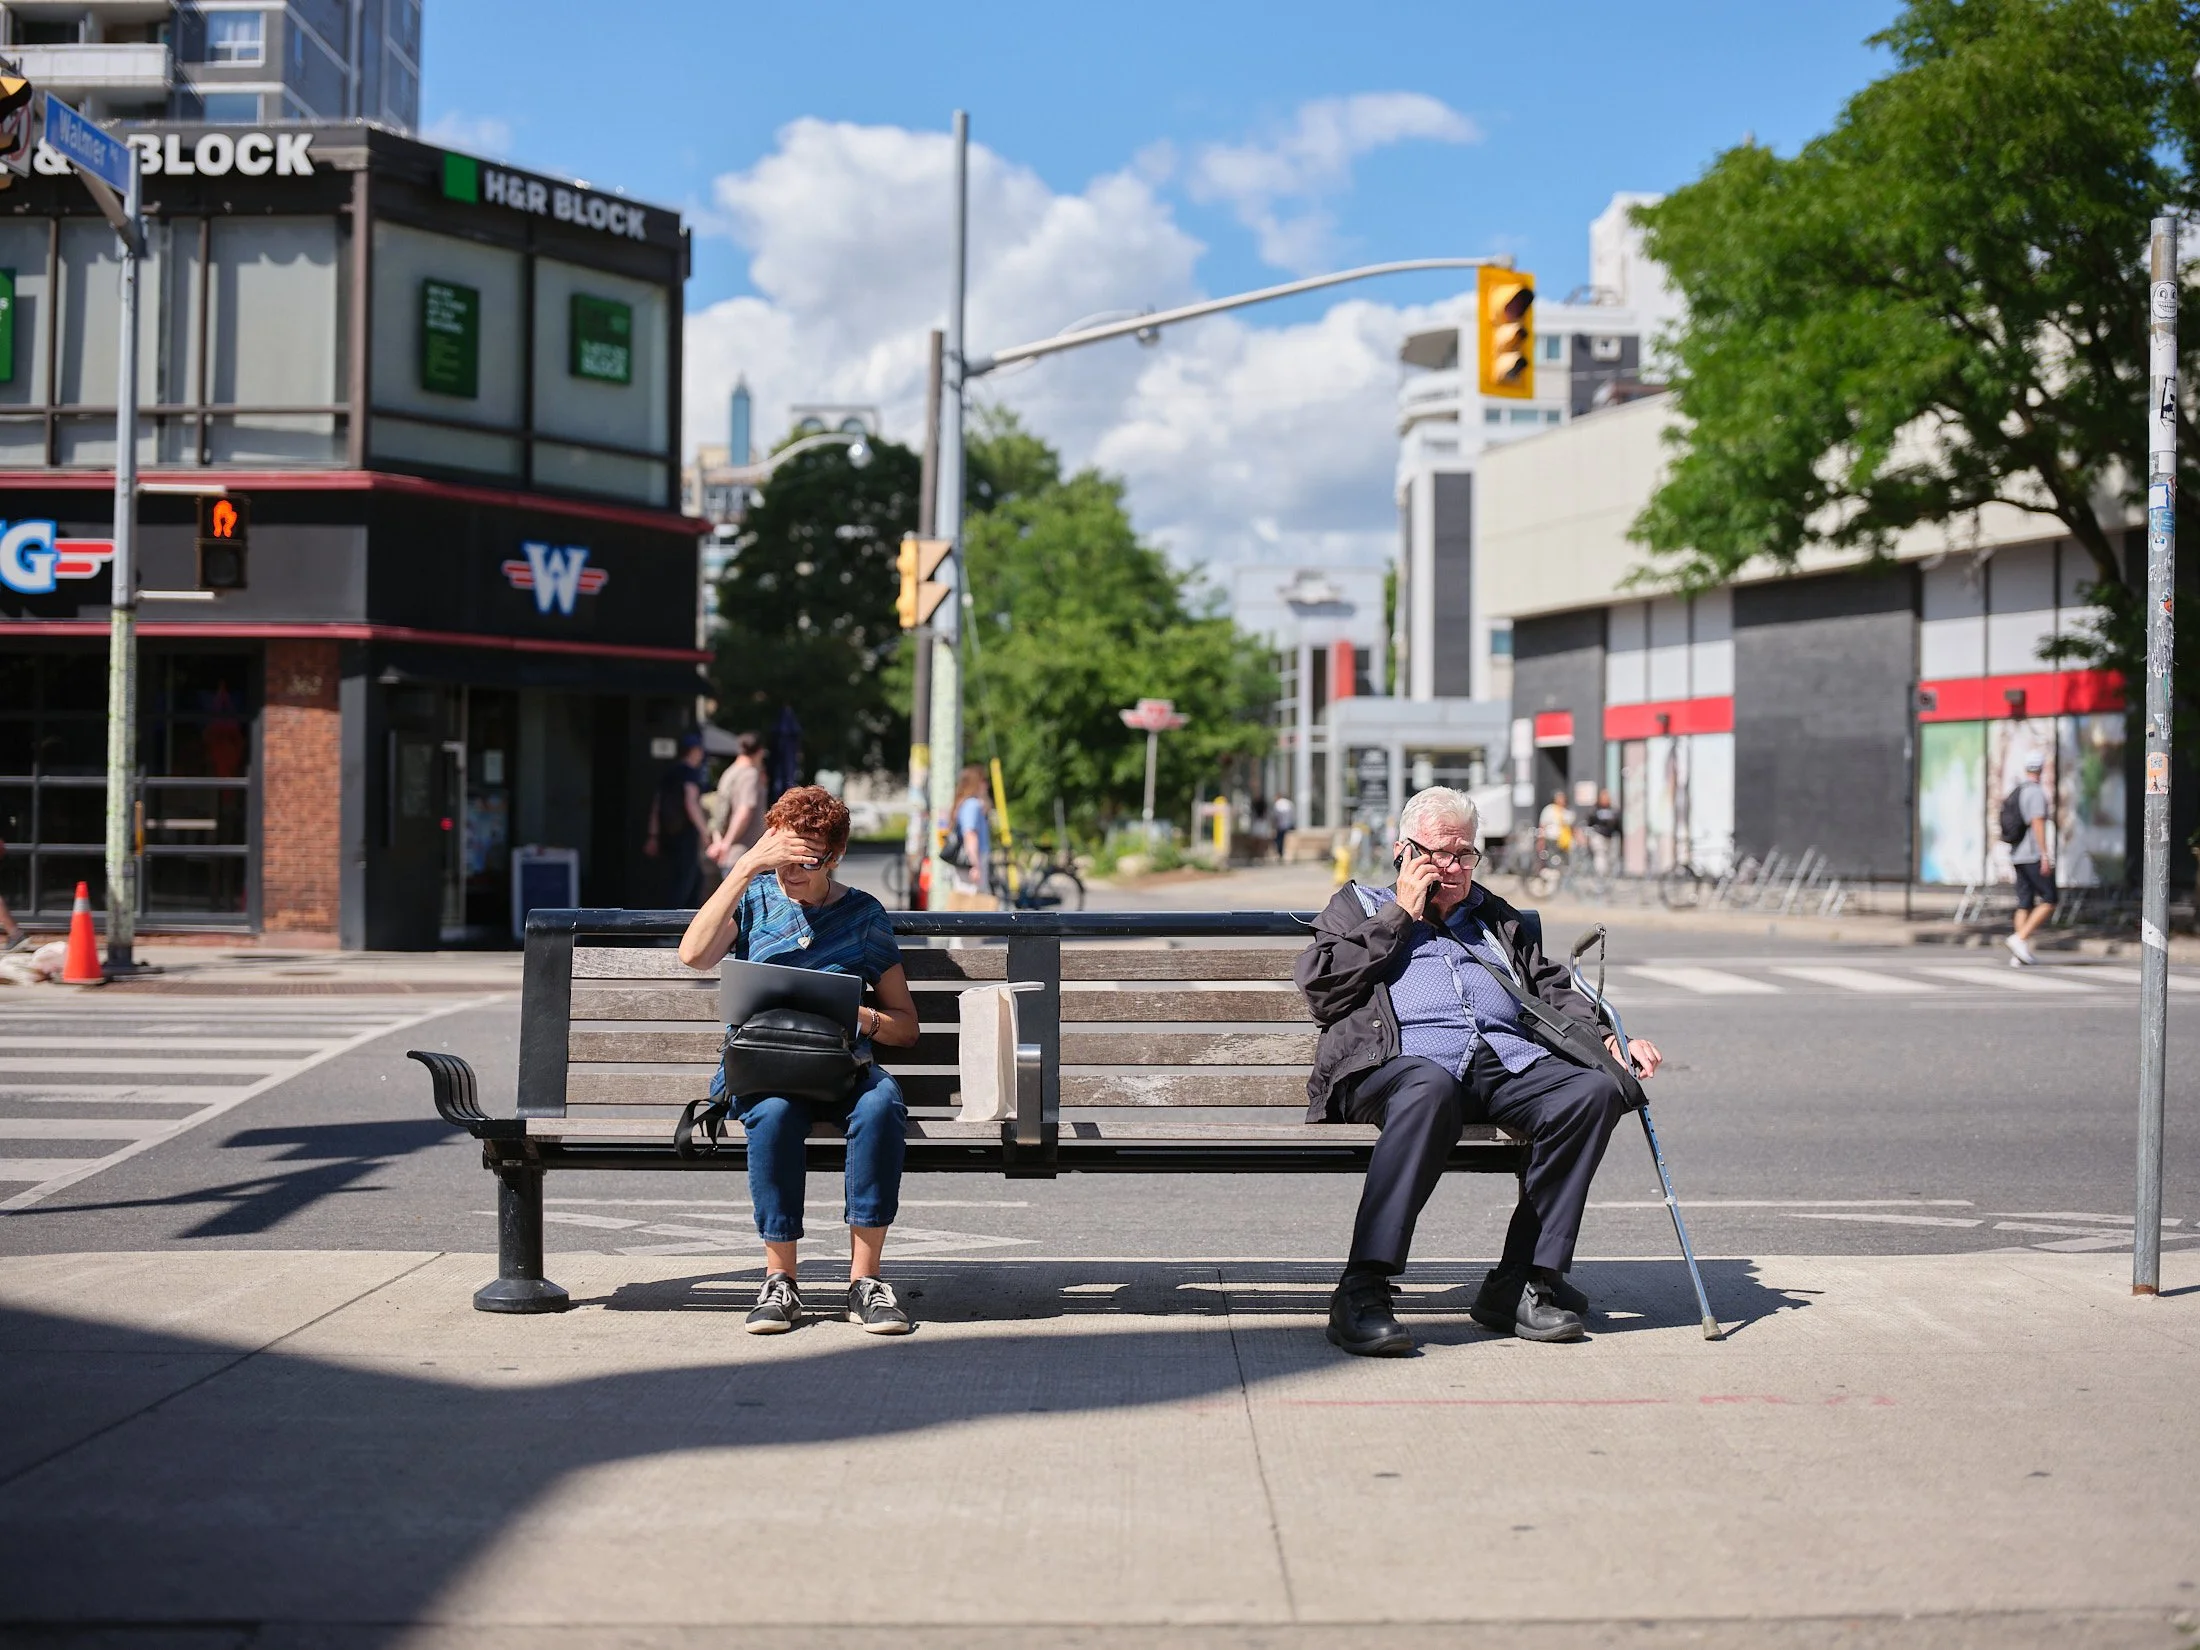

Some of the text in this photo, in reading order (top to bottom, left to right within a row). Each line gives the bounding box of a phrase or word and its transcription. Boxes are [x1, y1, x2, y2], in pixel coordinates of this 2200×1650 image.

[59, 108, 106, 167] Walmer
[126, 132, 315, 176] BLOCK
[484, 169, 647, 241] H&R BLOCK
[521, 541, 590, 616] W
